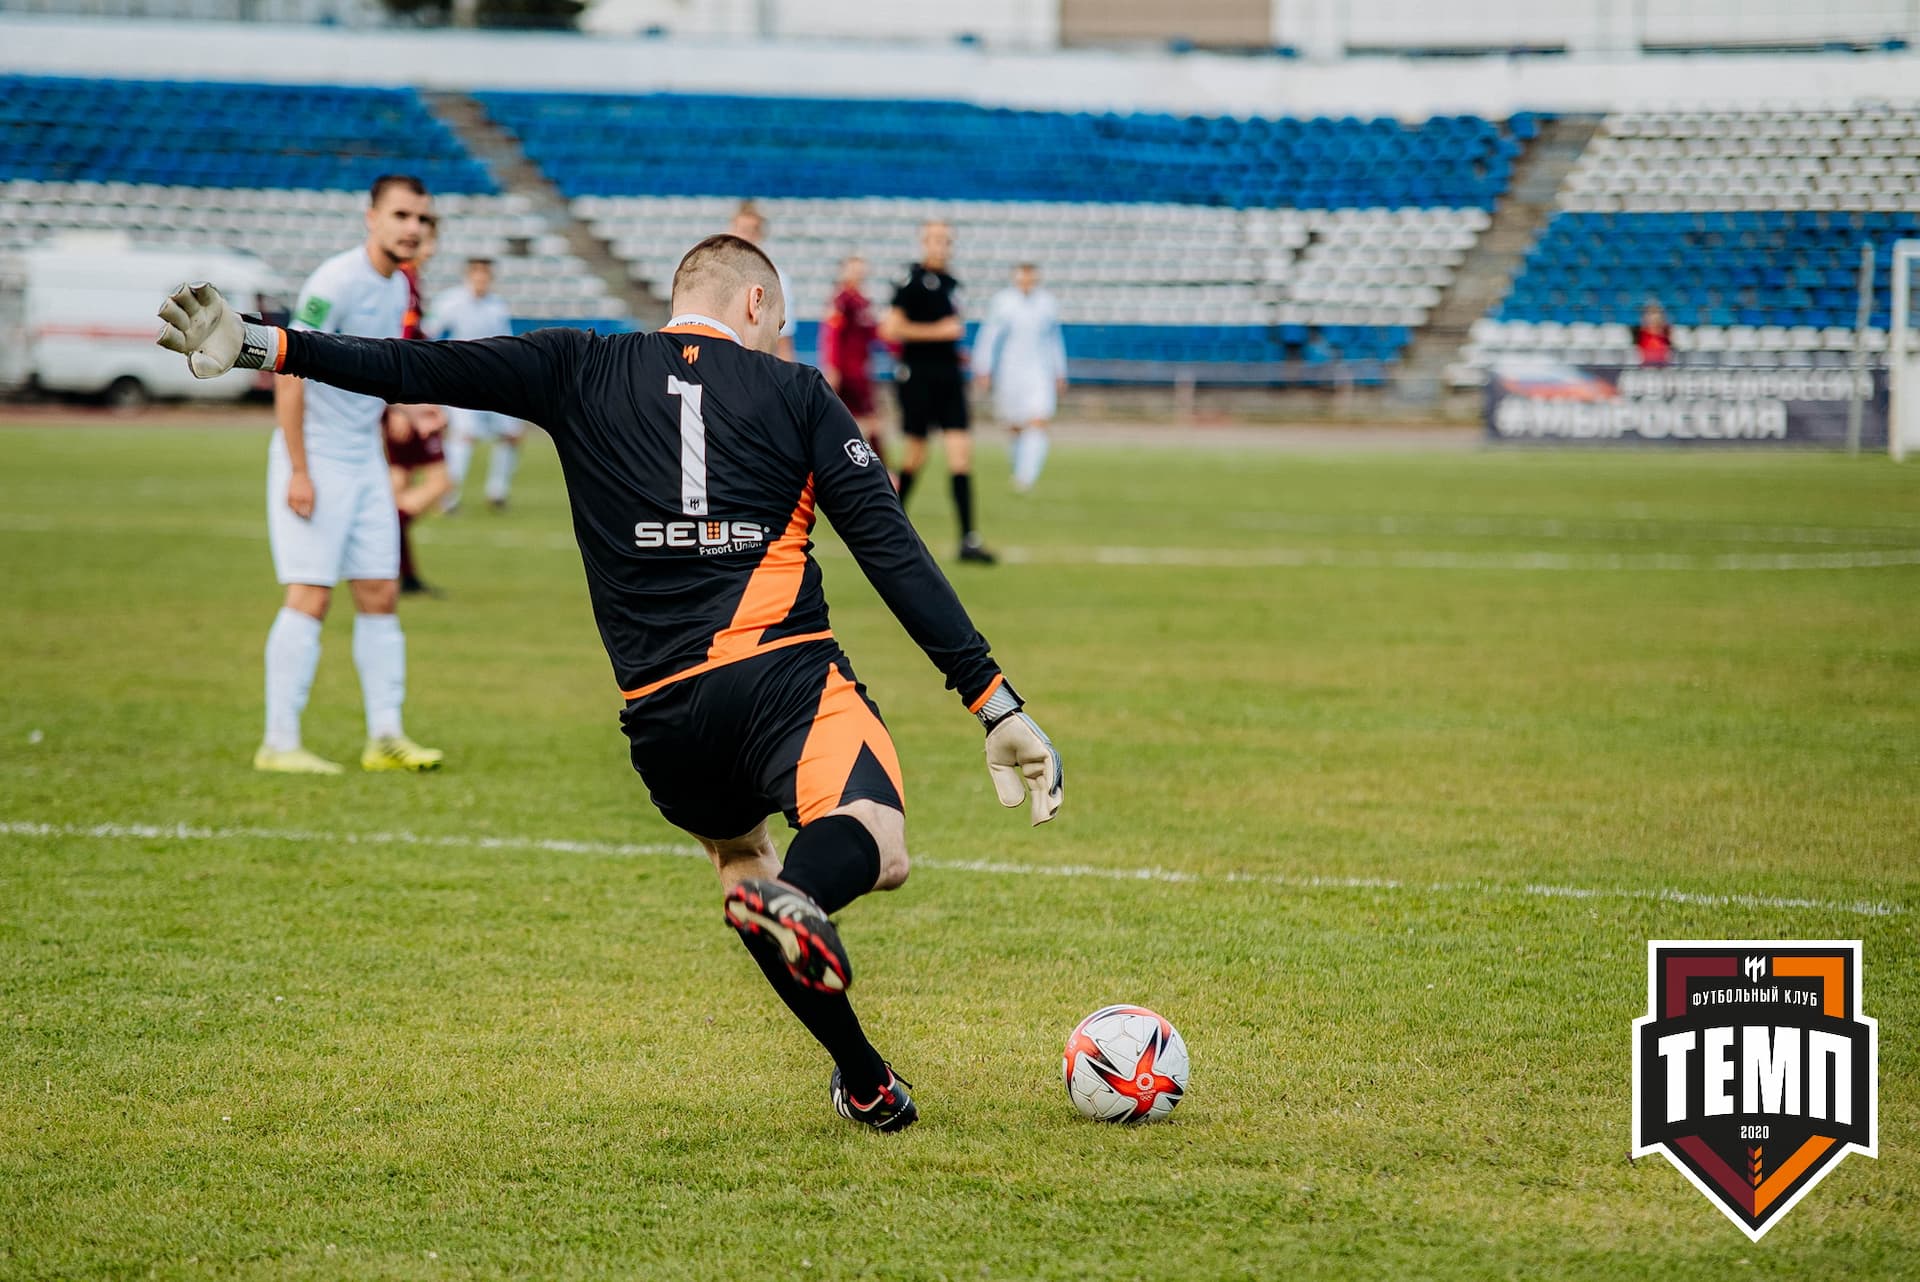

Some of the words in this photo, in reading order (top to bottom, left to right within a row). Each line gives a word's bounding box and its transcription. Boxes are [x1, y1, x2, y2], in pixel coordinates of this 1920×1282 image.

[1495, 397, 1788, 439] #МЫРОССИЯ
[667, 374, 708, 516] 1
[634, 521, 763, 547] SEUS
[699, 544, 733, 556] Export
